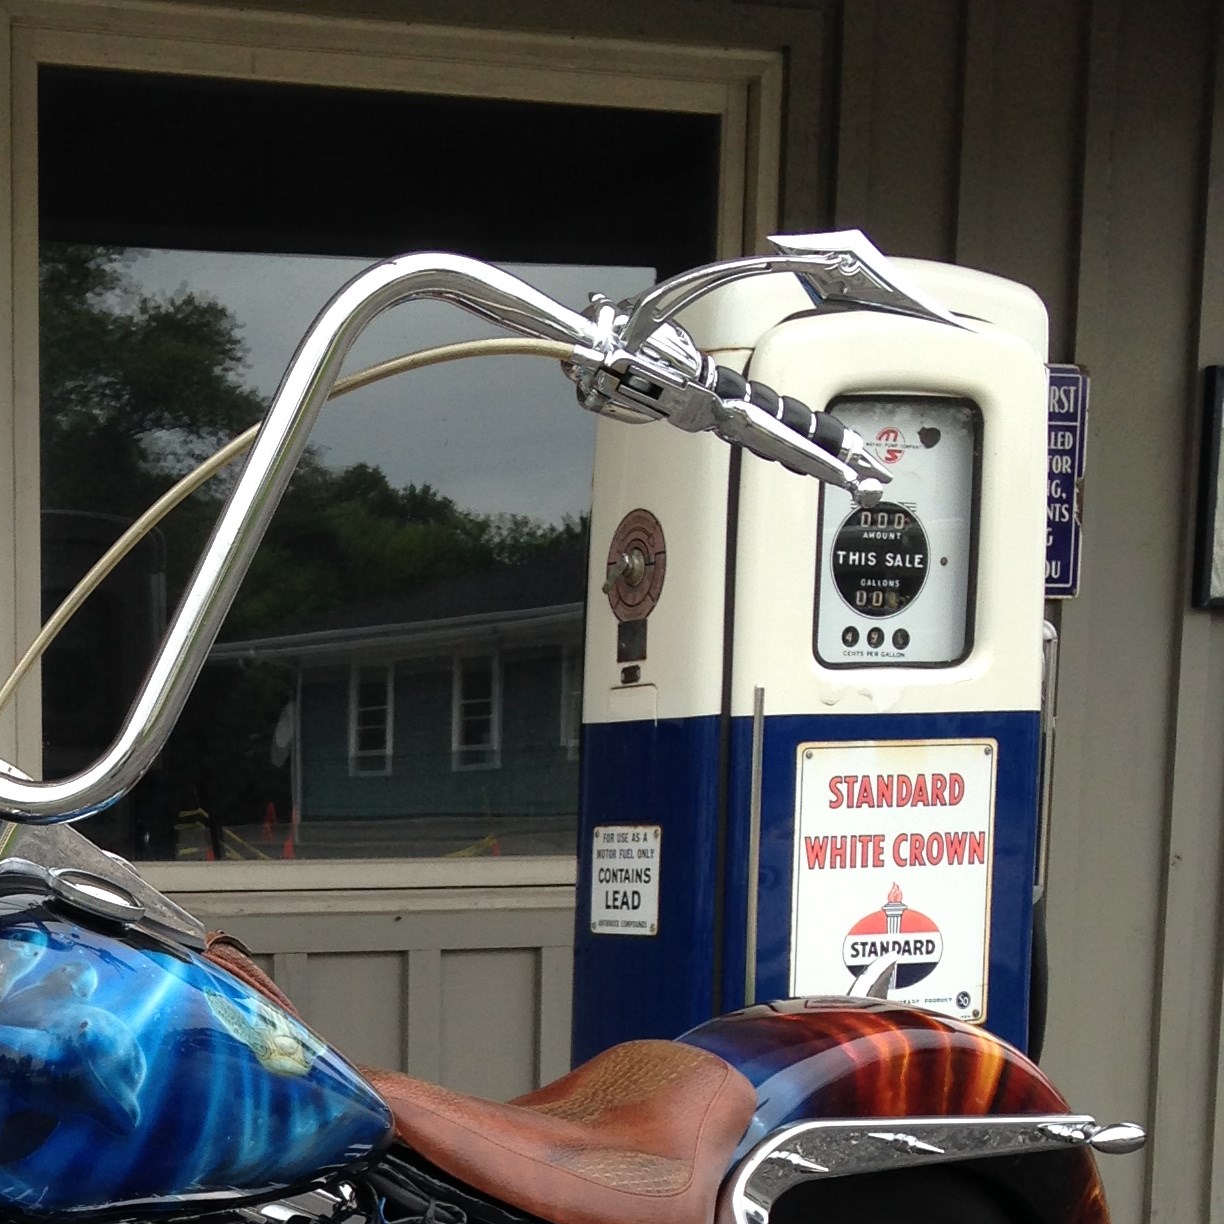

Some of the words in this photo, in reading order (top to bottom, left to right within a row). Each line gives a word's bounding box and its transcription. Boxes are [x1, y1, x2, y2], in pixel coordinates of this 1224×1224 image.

[1048, 431, 1074, 450] LED
[1048, 455, 1072, 474] OR
[862, 531, 902, 540] AMOUNT
[836, 551, 877, 566] THIS
[884, 552, 924, 568] SALE
[860, 578, 900, 588] GALLONS
[828, 772, 965, 809] STANDARD
[603, 832, 615, 843] FOR
[616, 832, 629, 843] USE
[631, 832, 641, 843] AS
[642, 832, 648, 842] A
[597, 849, 617, 859] MOTOR
[619, 848, 634, 859] FUEL
[637, 848, 655, 859] ONLY
[804, 833, 886, 870] WHITE
[892, 831, 986, 868] CROWN
[598, 867, 652, 884] CONTAINS
[605, 889, 642, 910] LEAD
[850, 939, 936, 958] STANDARD
